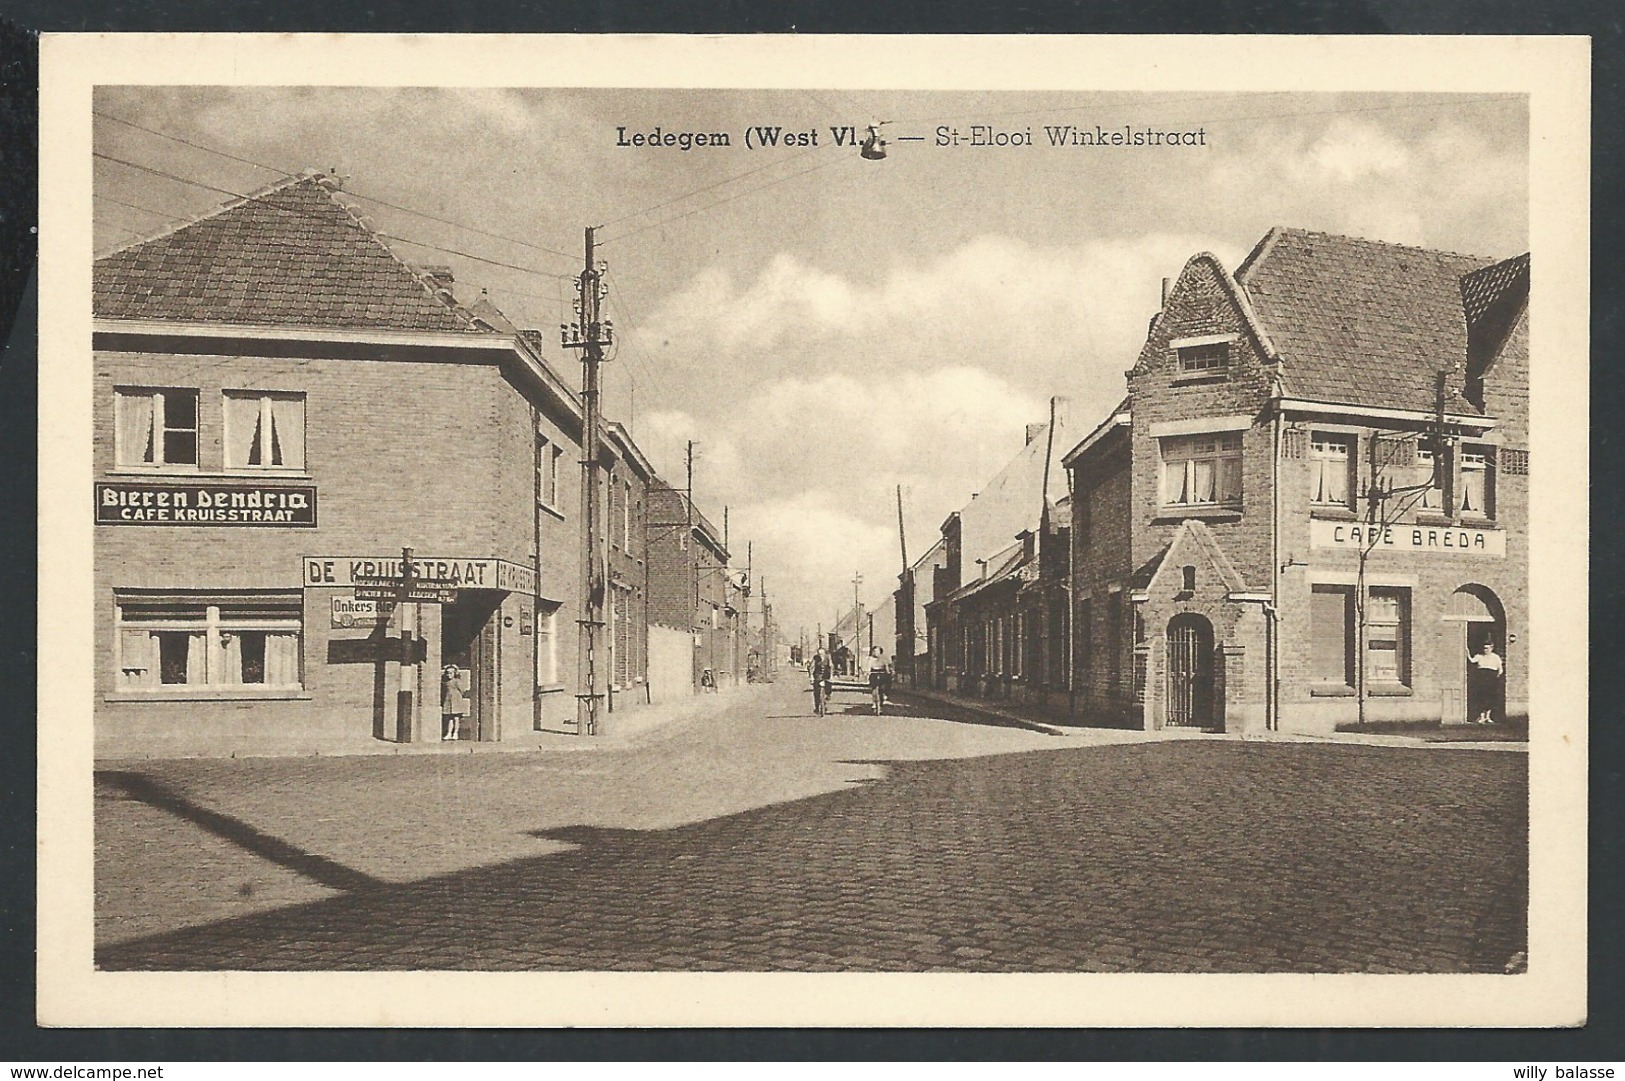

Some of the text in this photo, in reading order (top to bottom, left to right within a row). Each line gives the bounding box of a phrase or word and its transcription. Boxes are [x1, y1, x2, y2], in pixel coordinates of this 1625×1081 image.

[102, 488, 309, 509] Bieren Dendria
[120, 508, 295, 522] CAFE KRUISSTRAAT
[1334, 526, 1485, 549] CAFE BREDA
[309, 561, 335, 583] DE
